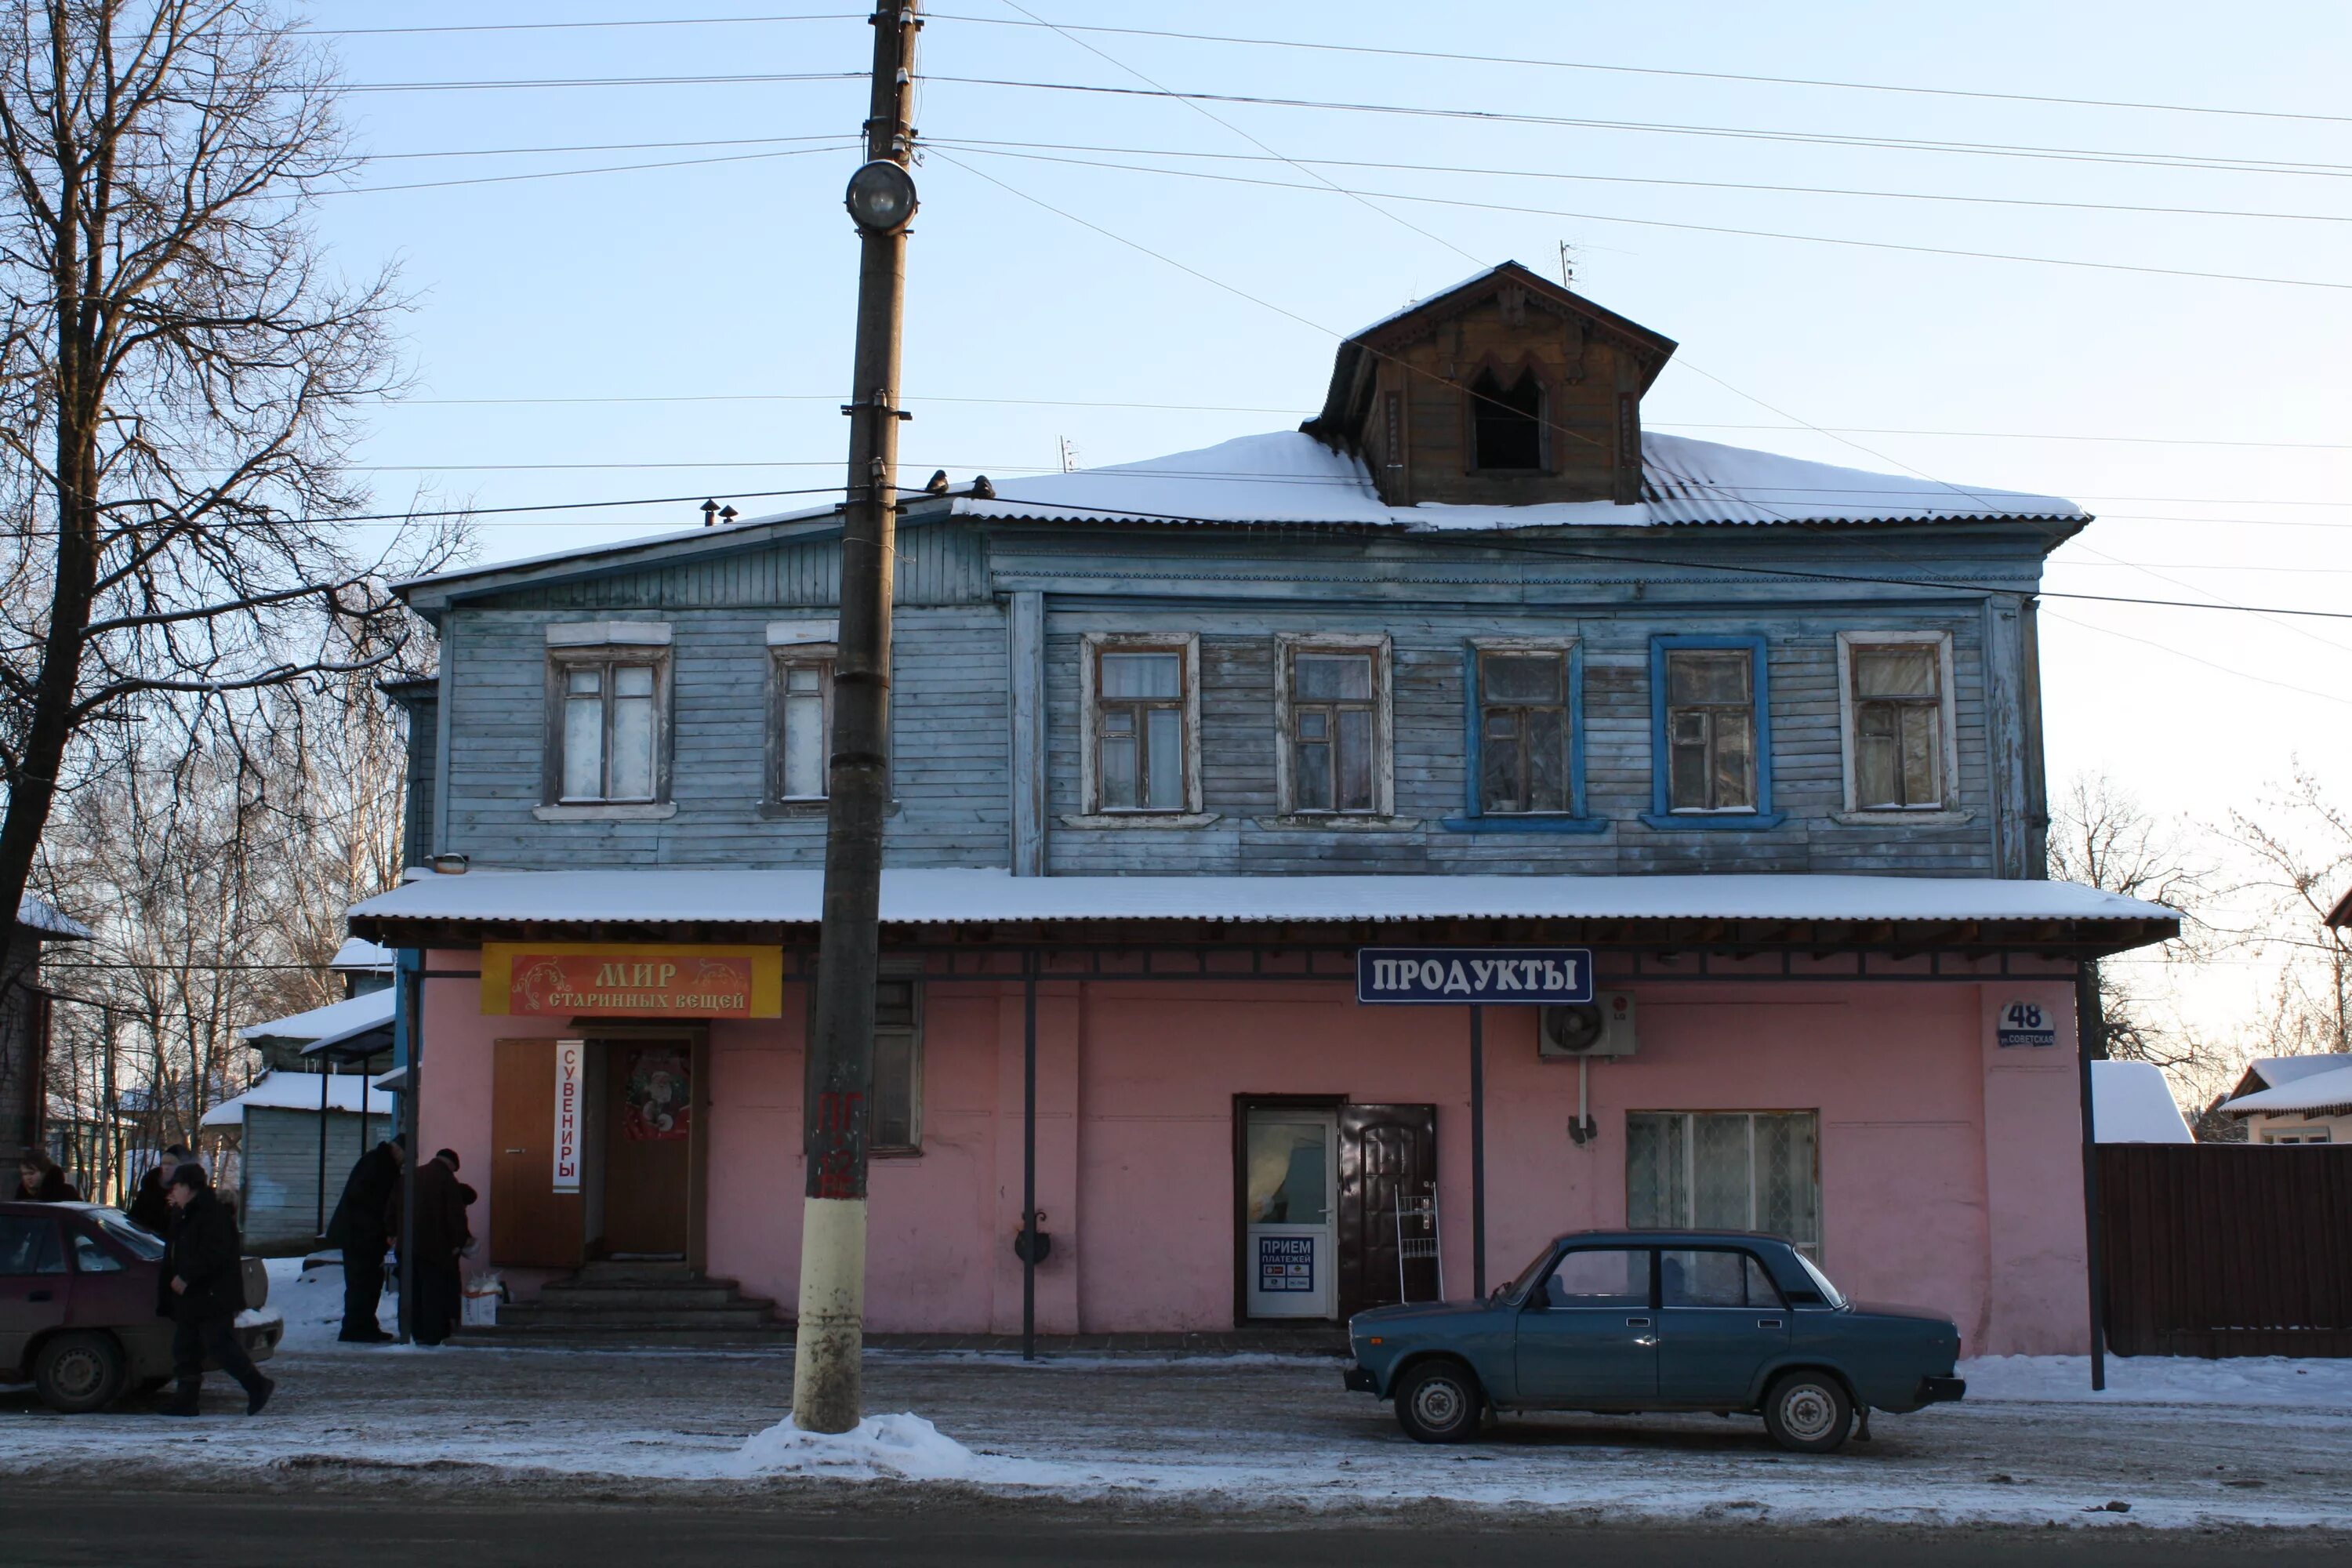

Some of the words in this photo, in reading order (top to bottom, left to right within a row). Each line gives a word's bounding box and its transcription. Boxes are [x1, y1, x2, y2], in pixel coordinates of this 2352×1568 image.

[595, 963, 678, 988] МИР
[1372, 959, 1578, 995] ПРОДУКТЫ
[548, 993, 669, 1009] СТАРИННЫХ
[674, 992, 746, 1011] ВЕЩЕЙ
[2008, 1004, 2042, 1028] 48
[559, 1050, 575, 1177] СУВЕНИРЫ
[1261, 1254, 1311, 1263] ПЛАТЕЖЕЙ
[1262, 1240, 1311, 1254] ПРИЕМ
